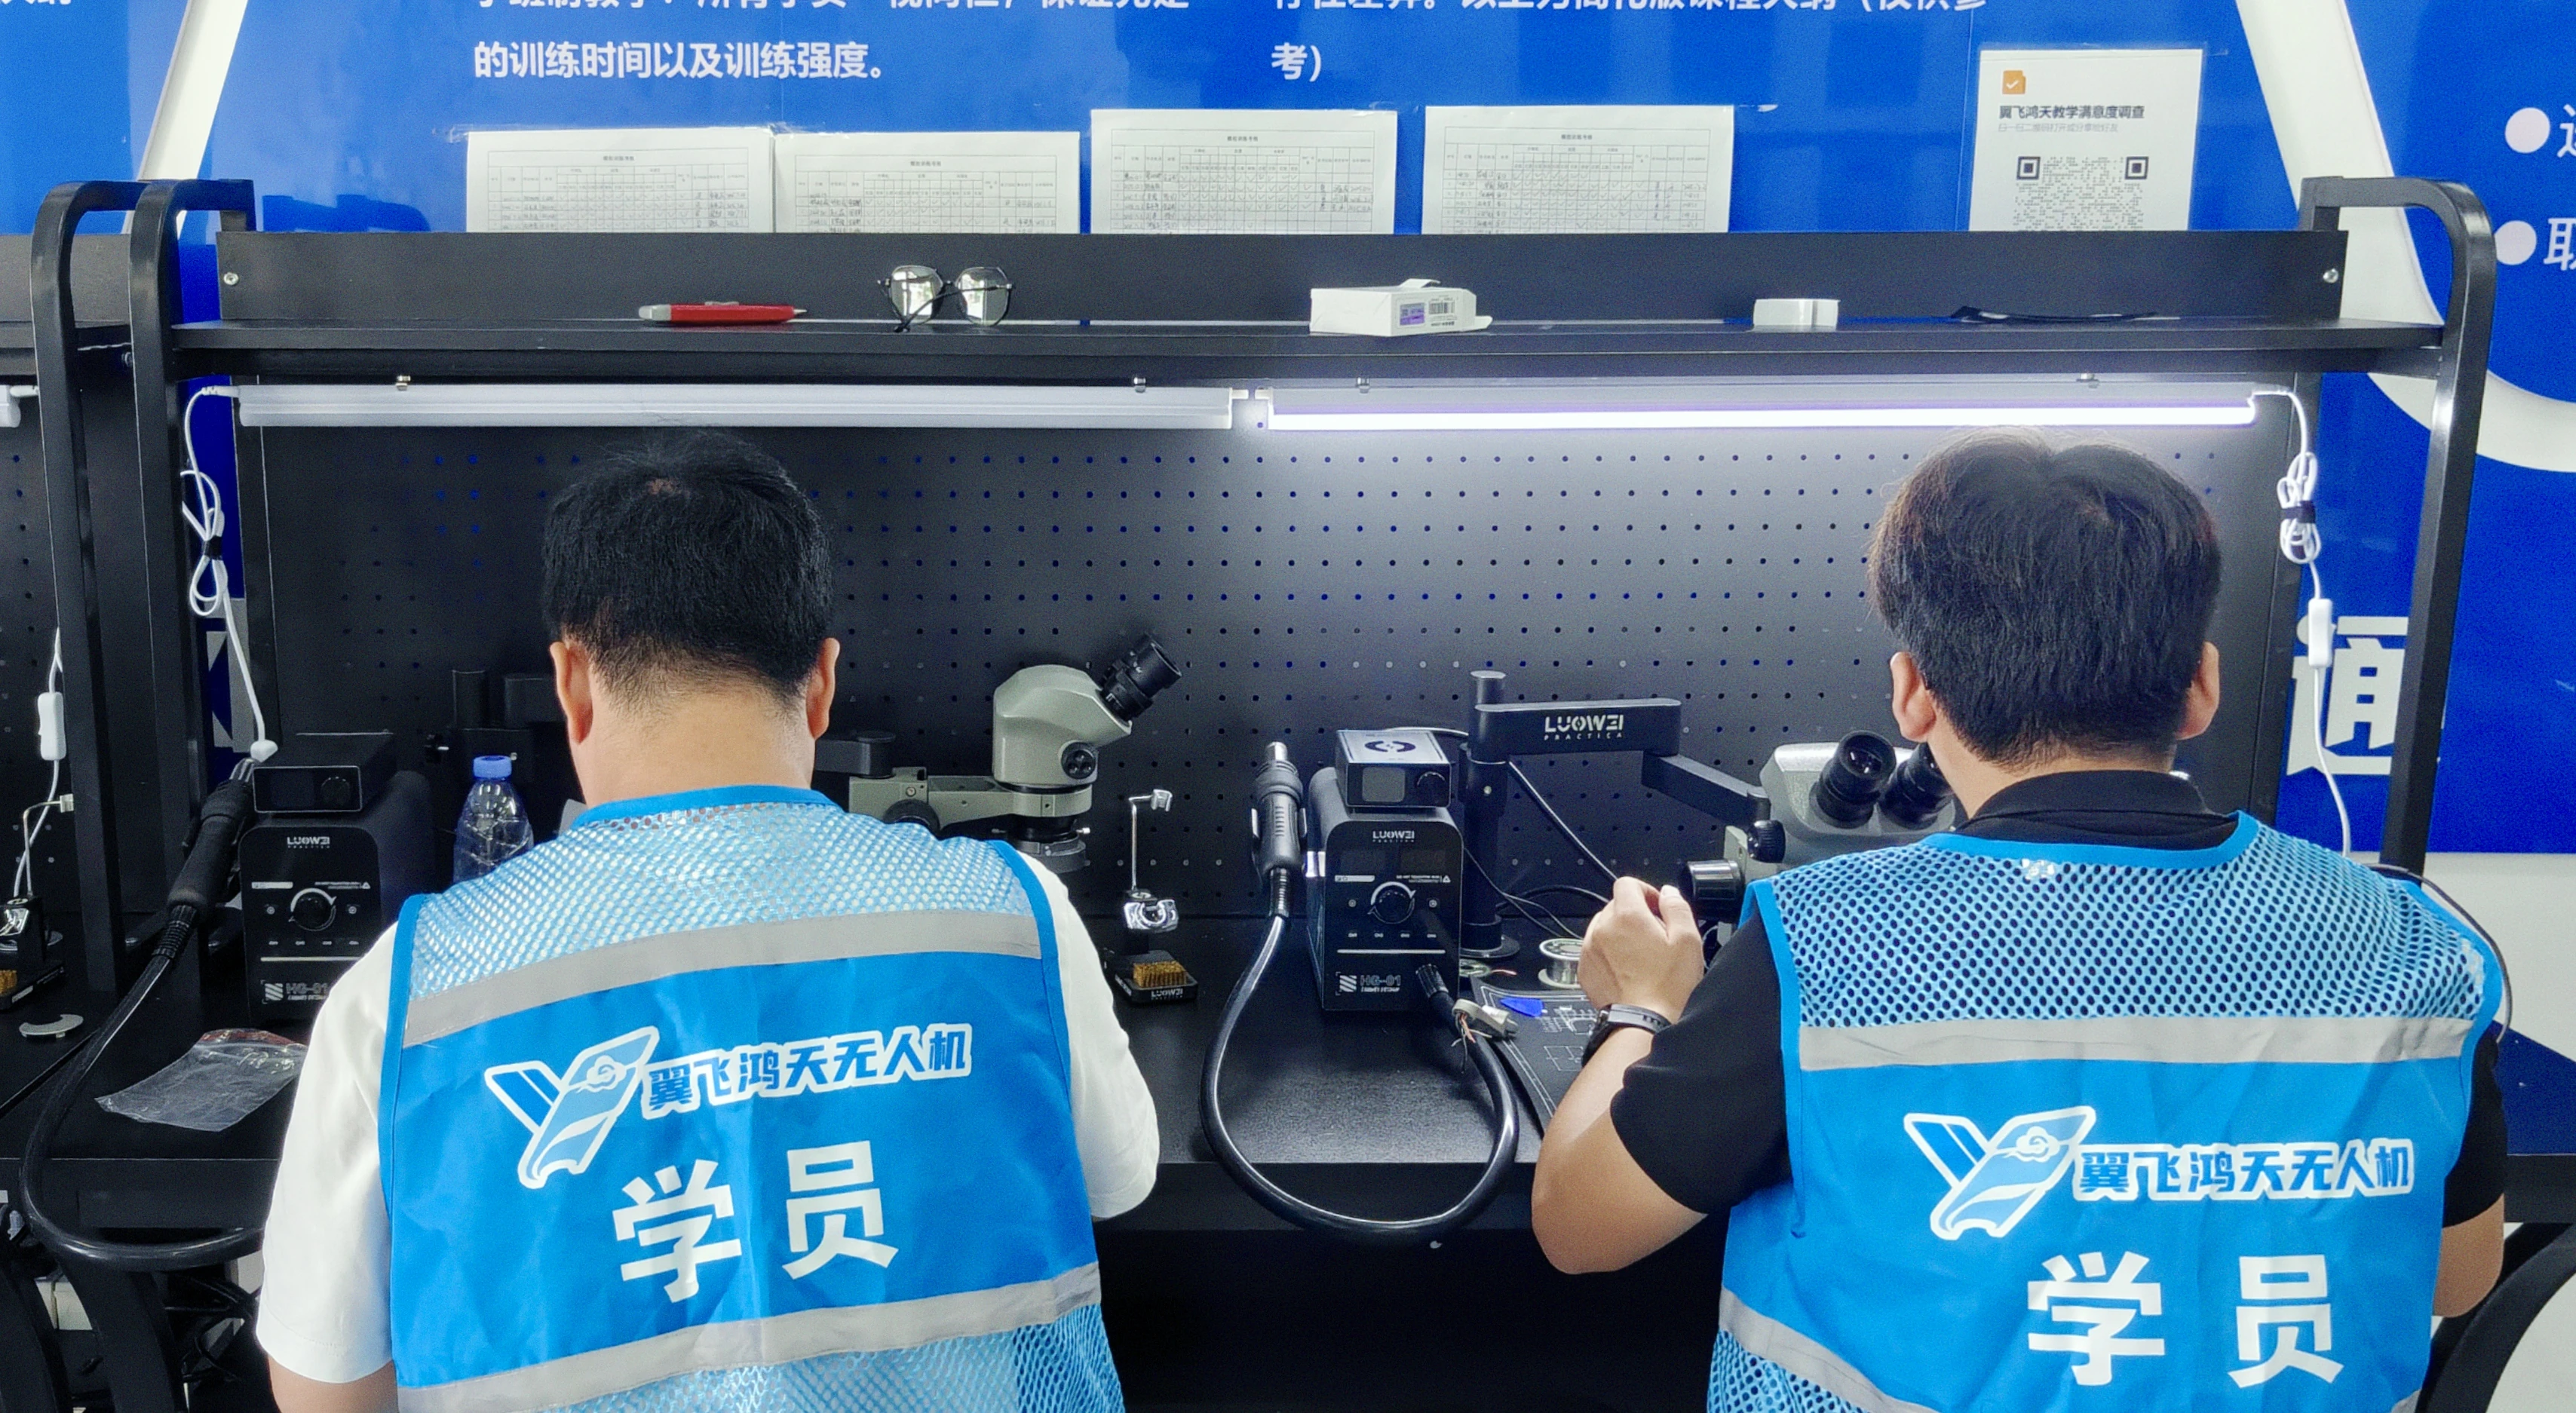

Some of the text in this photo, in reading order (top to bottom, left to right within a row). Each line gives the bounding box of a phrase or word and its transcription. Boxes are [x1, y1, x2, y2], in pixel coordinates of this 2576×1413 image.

[474, 41, 882, 79] 的训练时间以及训练强度。
[1999, 105, 2145, 119] 翼飞鸿天教学满意度调查
[1545, 714, 1624, 733] LUOWEI
[1372, 830, 1415, 839] LUOWEI
[644, 1027, 970, 1114] 翼飞鸿天无人机
[2077, 1142, 2411, 1197] 翼飞鸿天无人机
[612, 1140, 899, 1303] 学员
[2028, 1251, 2344, 1388] 学员
